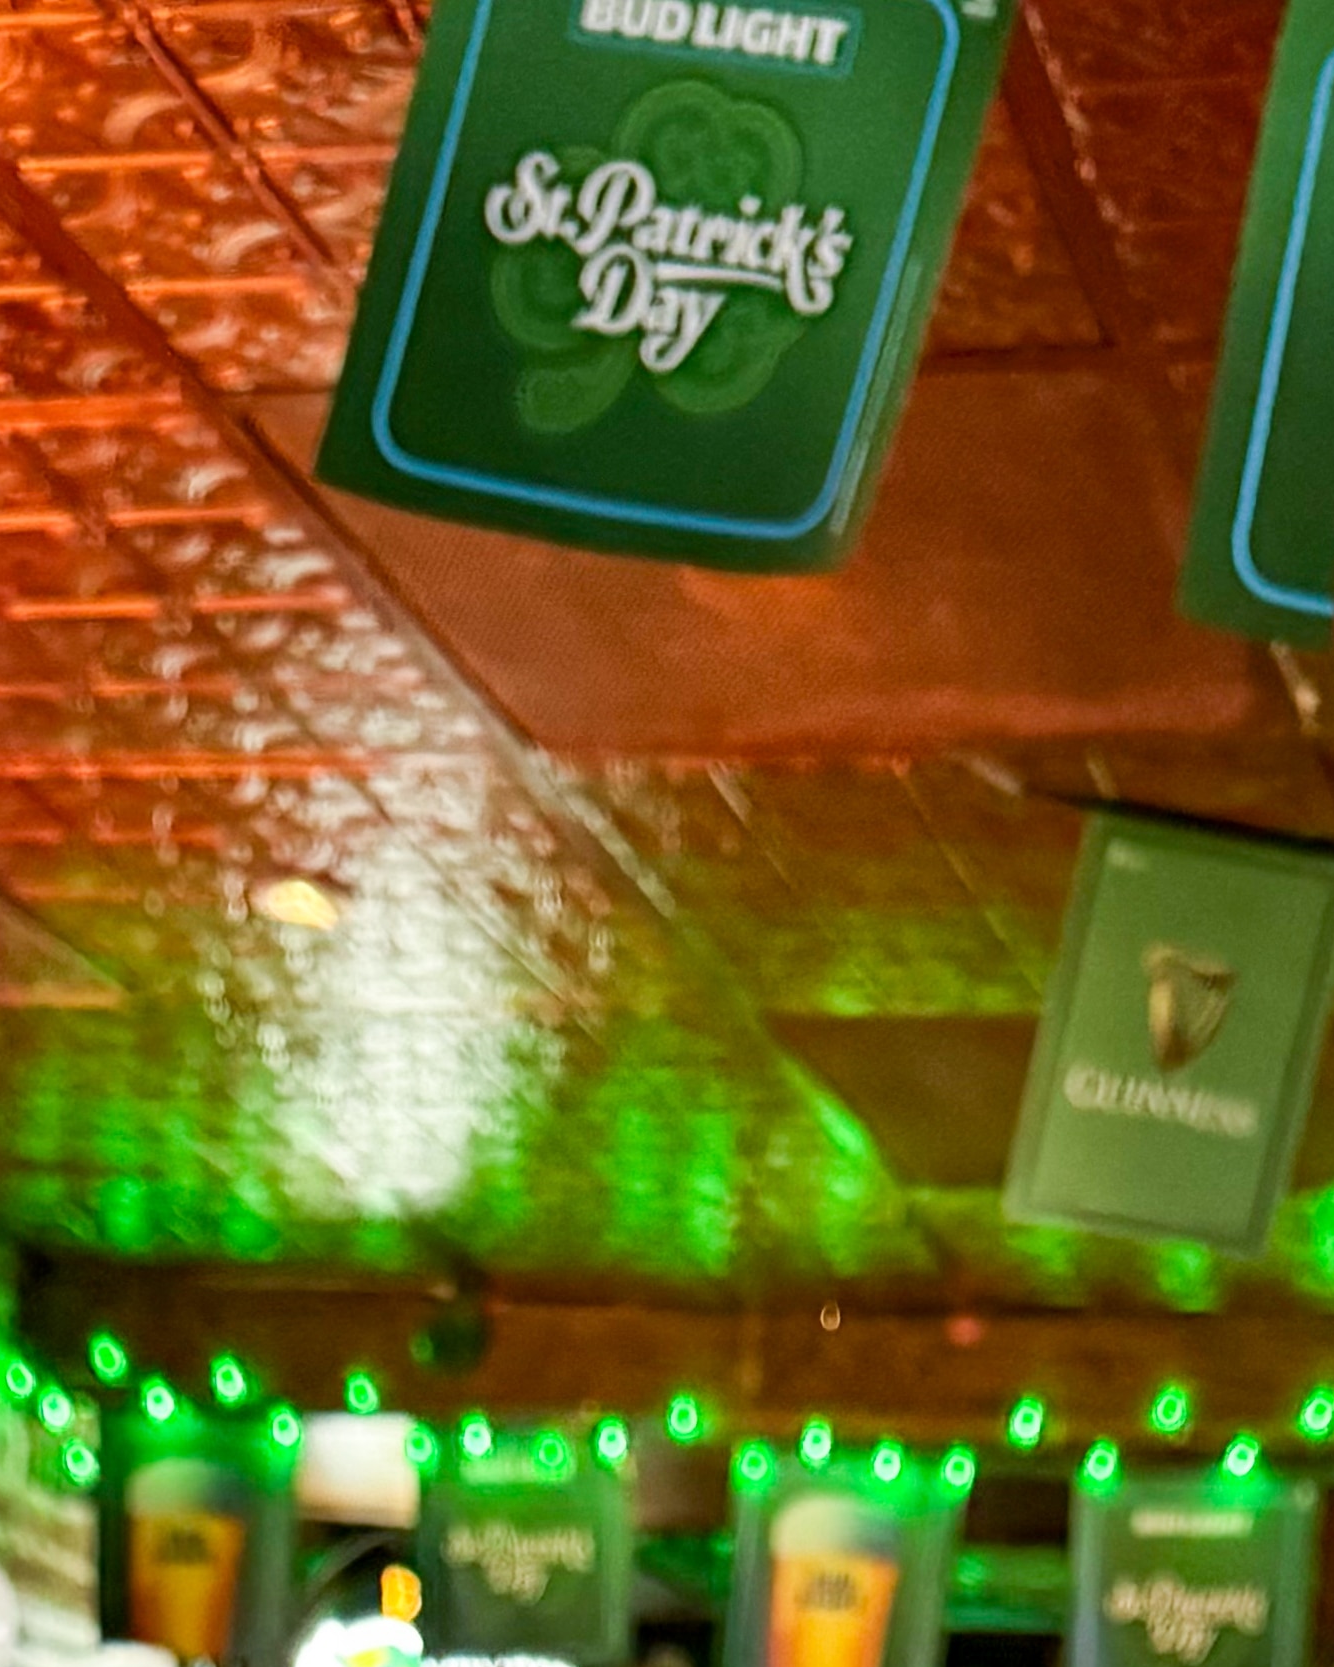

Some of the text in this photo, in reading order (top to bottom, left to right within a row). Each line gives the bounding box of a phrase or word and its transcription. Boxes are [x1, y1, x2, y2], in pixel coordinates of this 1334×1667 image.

[580, 0, 850, 66] BUD LIGHT
[483, 151, 855, 316] St. Patrick's
[571, 244, 727, 373] Day
